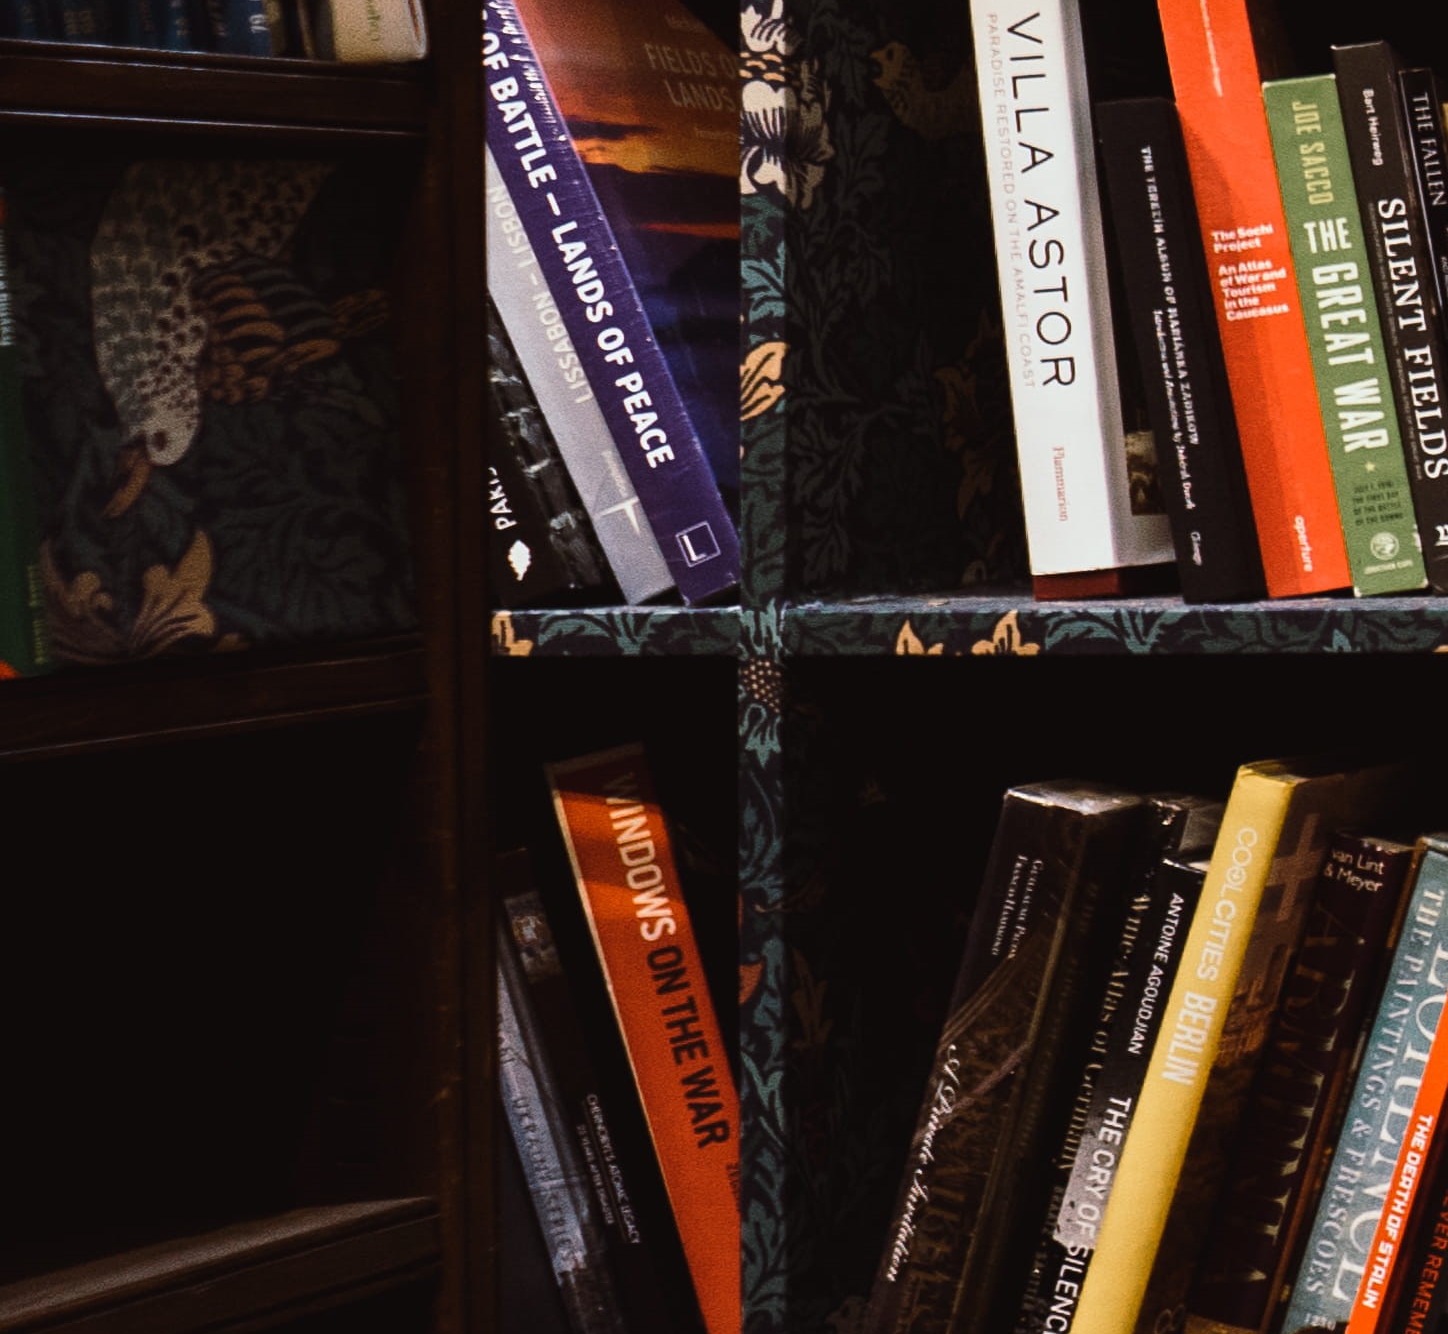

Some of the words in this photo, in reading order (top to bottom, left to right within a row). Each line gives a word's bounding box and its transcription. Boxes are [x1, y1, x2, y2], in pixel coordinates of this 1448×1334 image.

[1006, 11, 1054, 173] VILLA
[1292, 97, 1322, 136] JOE
[1299, 139, 1335, 206] SACCO
[1302, 214, 1353, 256] THE
[1377, 197, 1427, 331] SILENT
[488, 73, 558, 190] BATTLE
[549, 219, 614, 325] LANDS
[593, 324, 633, 371] OF
[614, 371, 675, 470] PEACE
[1023, 199, 1075, 386] ASTOR
[1311, 260, 1374, 371] GREAT
[1333, 377, 1390, 453] WAR
[644, 943, 691, 996] ON
[659, 995, 709, 1066] THE
[676, 1065, 732, 1151] WAR
[1097, 1091, 1132, 1147] THE
[1409, 1112, 1433, 1151] THE
[1082, 1147, 1116, 1199] CRY
[1390, 1150, 1421, 1215] DEATH
[1071, 1201, 1100, 1238] OF
[1382, 1213, 1403, 1240] OF
[1361, 1240, 1394, 1309] STALIN
